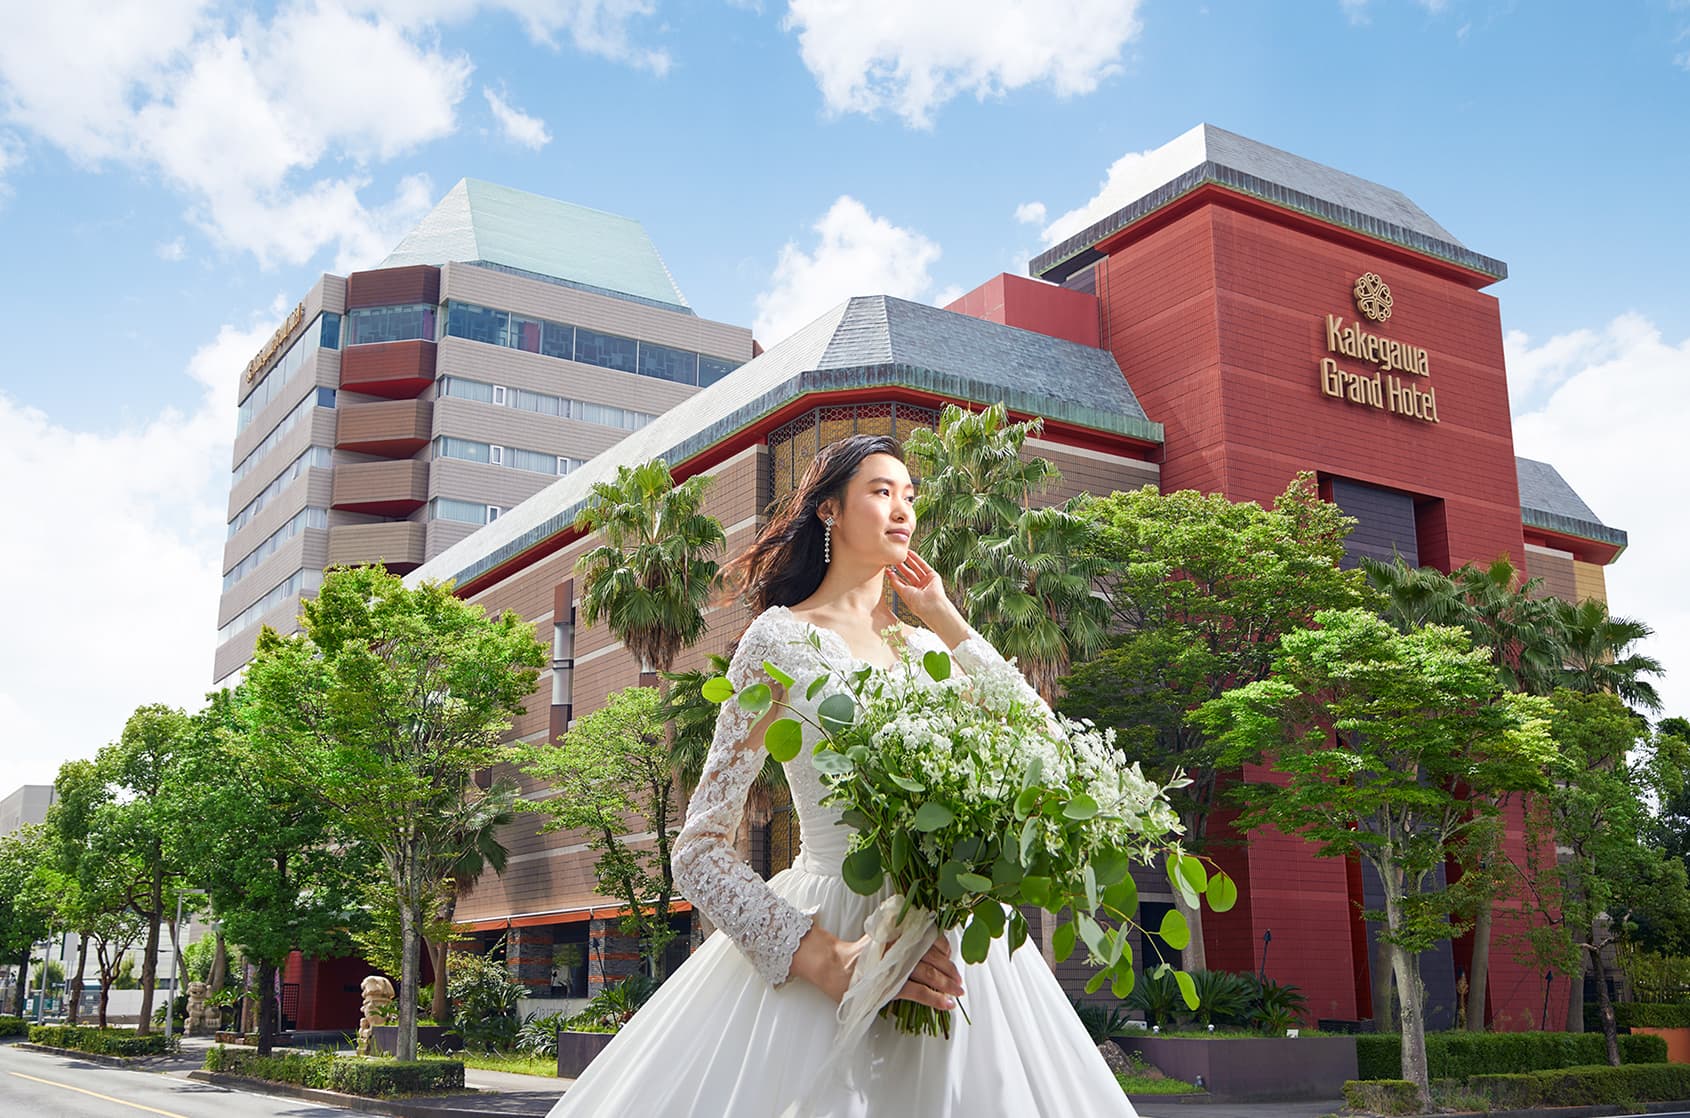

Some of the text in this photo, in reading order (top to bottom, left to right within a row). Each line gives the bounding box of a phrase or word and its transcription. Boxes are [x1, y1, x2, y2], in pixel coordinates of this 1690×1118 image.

[1325, 313, 1430, 377] Kakegawa
[1320, 357, 1440, 424] Grand Hotel
